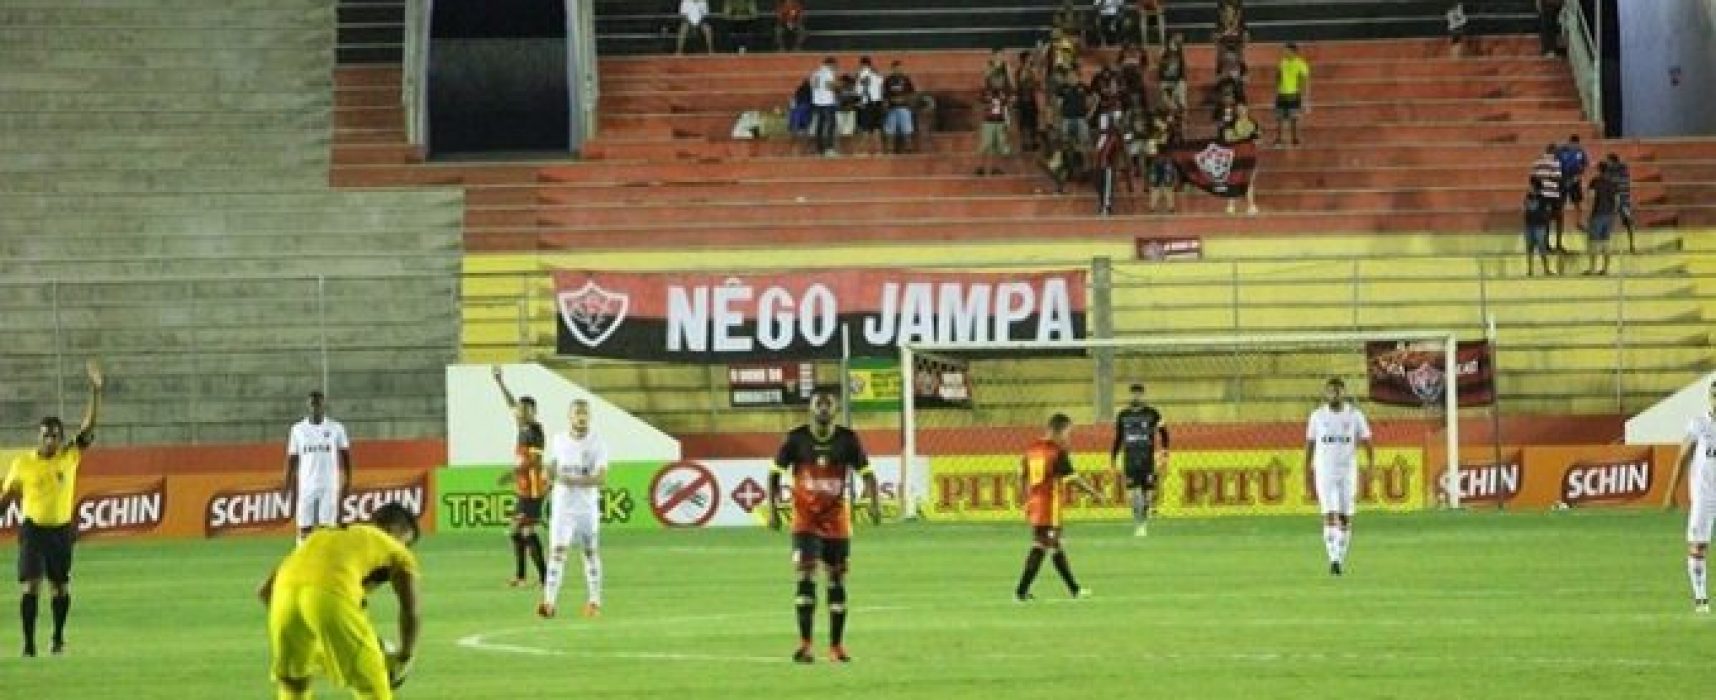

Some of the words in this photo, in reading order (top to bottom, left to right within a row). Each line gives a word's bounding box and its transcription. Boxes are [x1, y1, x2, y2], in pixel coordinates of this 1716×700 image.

[667, 277, 838, 352] NÊGO
[864, 278, 1075, 345] JAMPA
[1567, 462, 1649, 499] SCHIN
[78, 492, 161, 529] SCHIN
[209, 490, 292, 527] SCHIN
